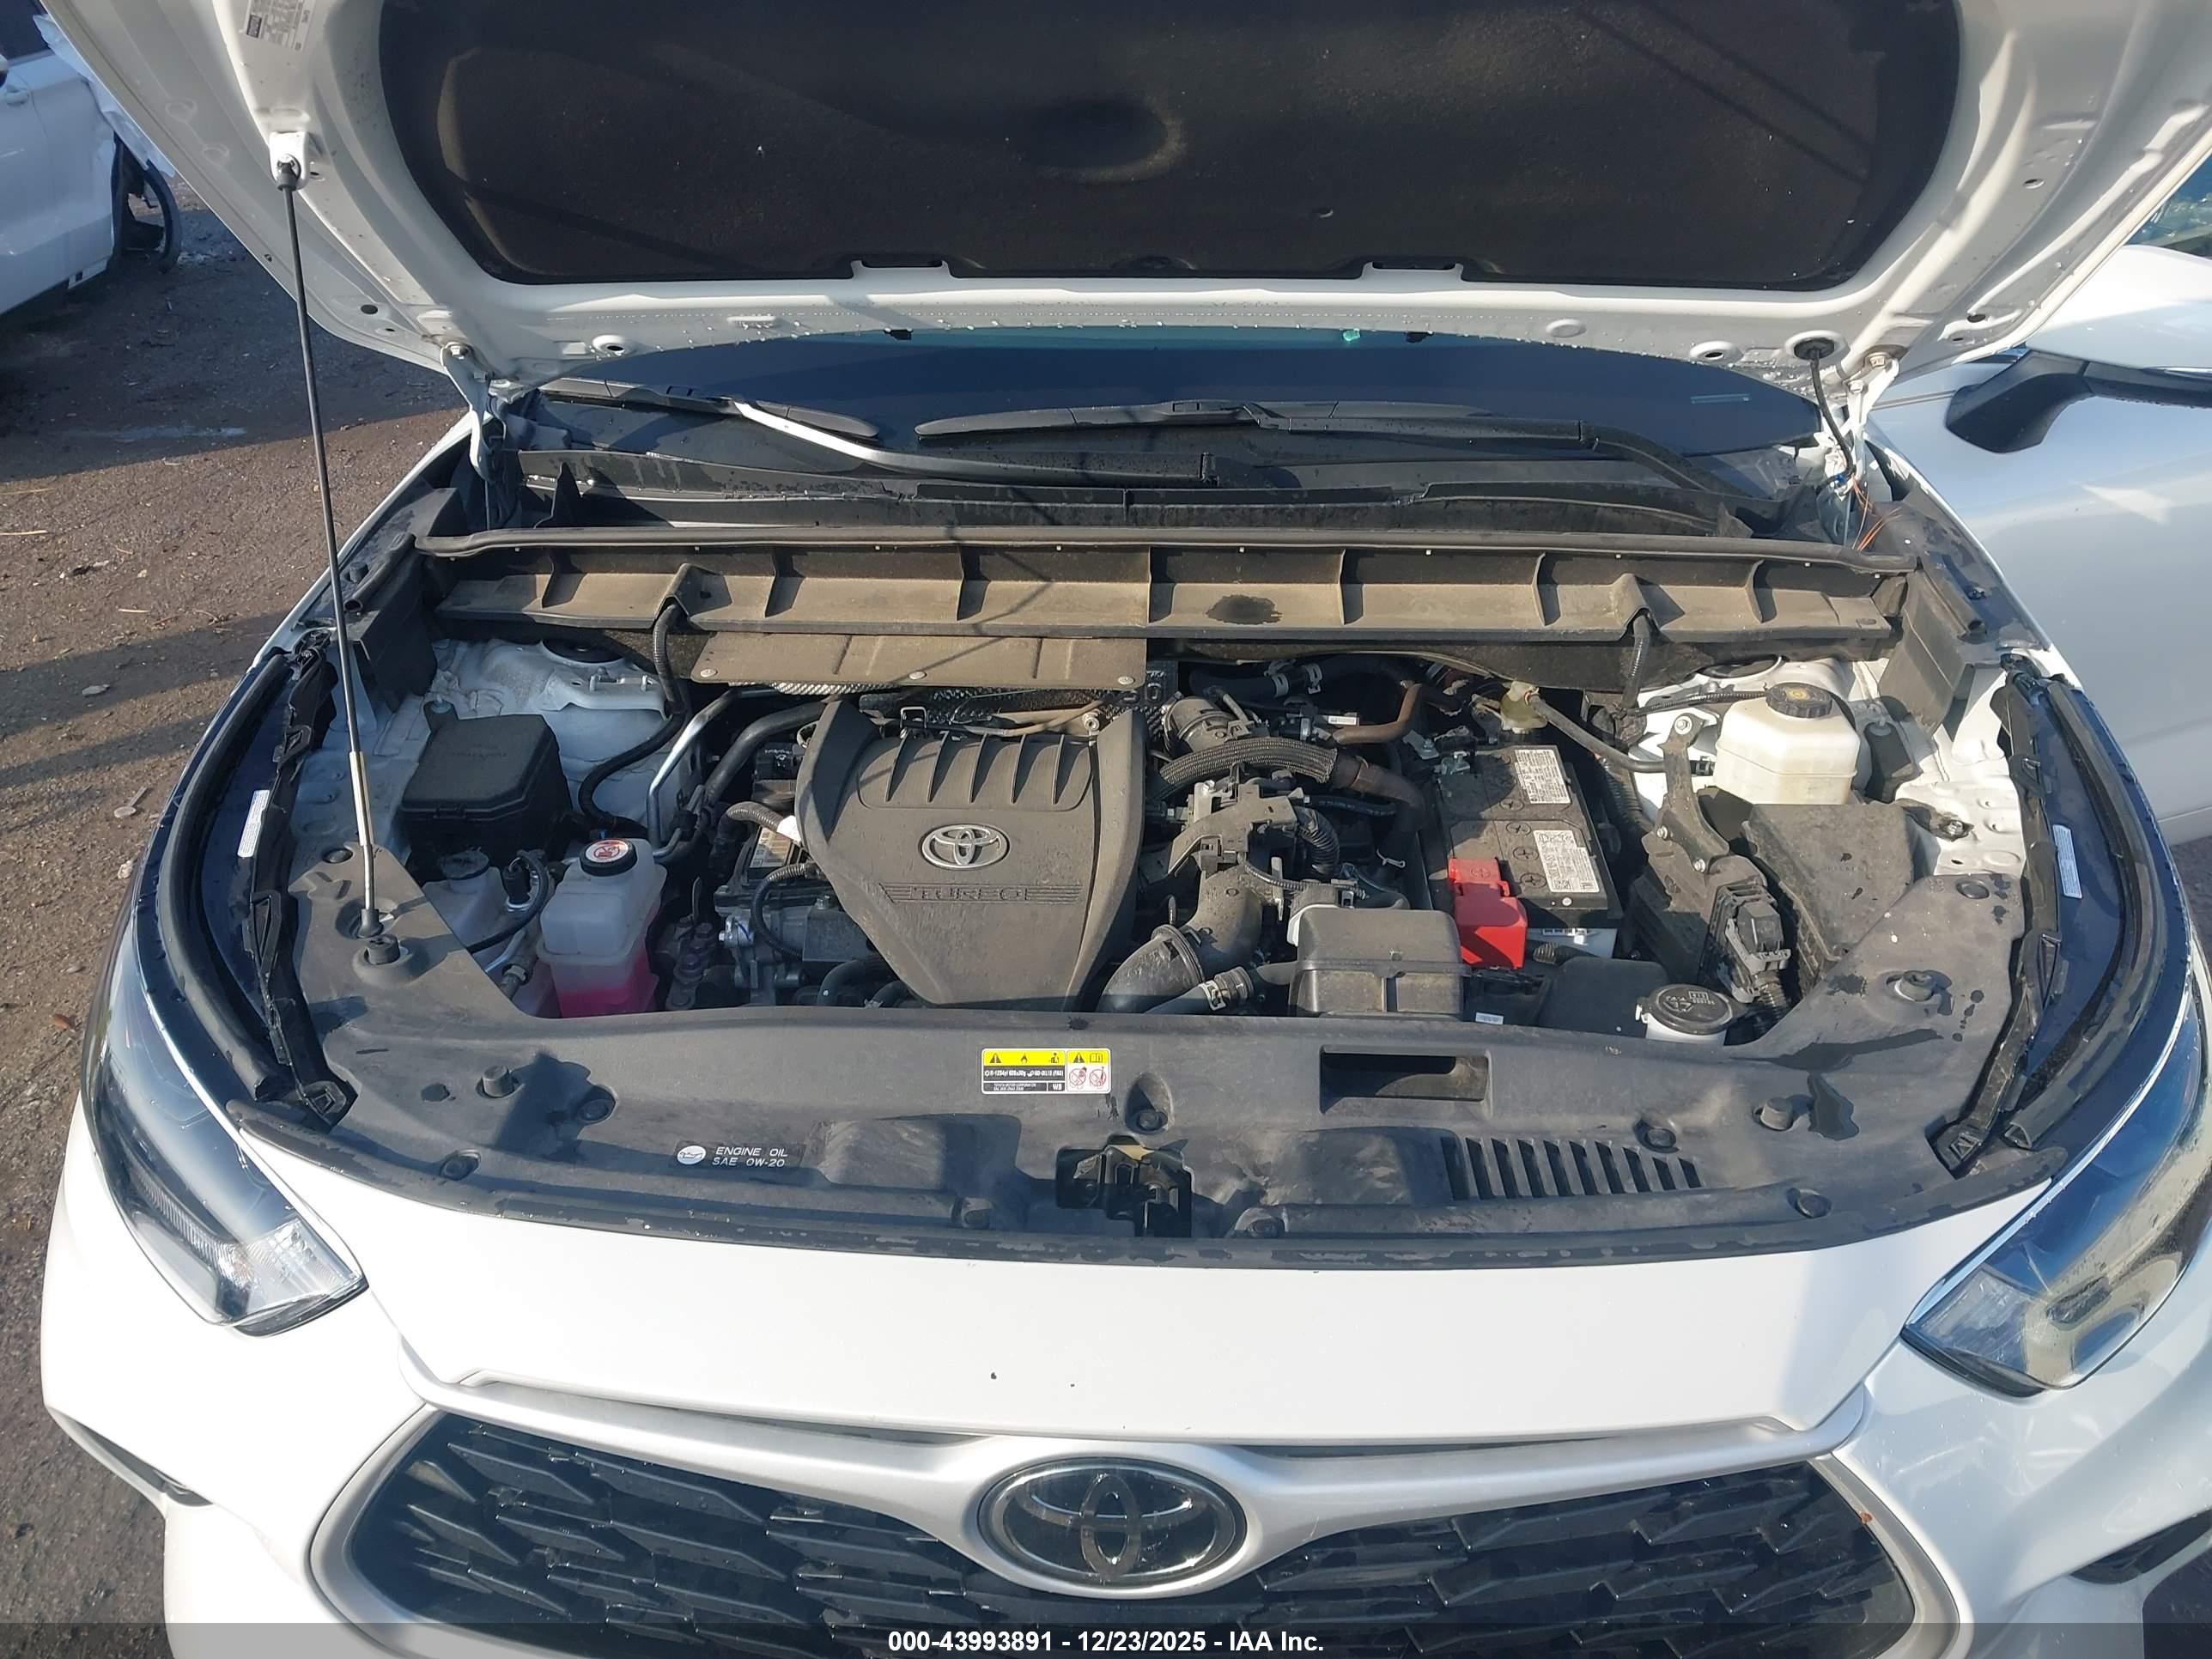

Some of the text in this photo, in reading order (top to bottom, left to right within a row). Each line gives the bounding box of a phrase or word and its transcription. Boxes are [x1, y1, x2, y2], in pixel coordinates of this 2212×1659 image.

[715, 1146, 788, 1158] ENGINE OIL
[712, 1157, 738, 1166] SAE
